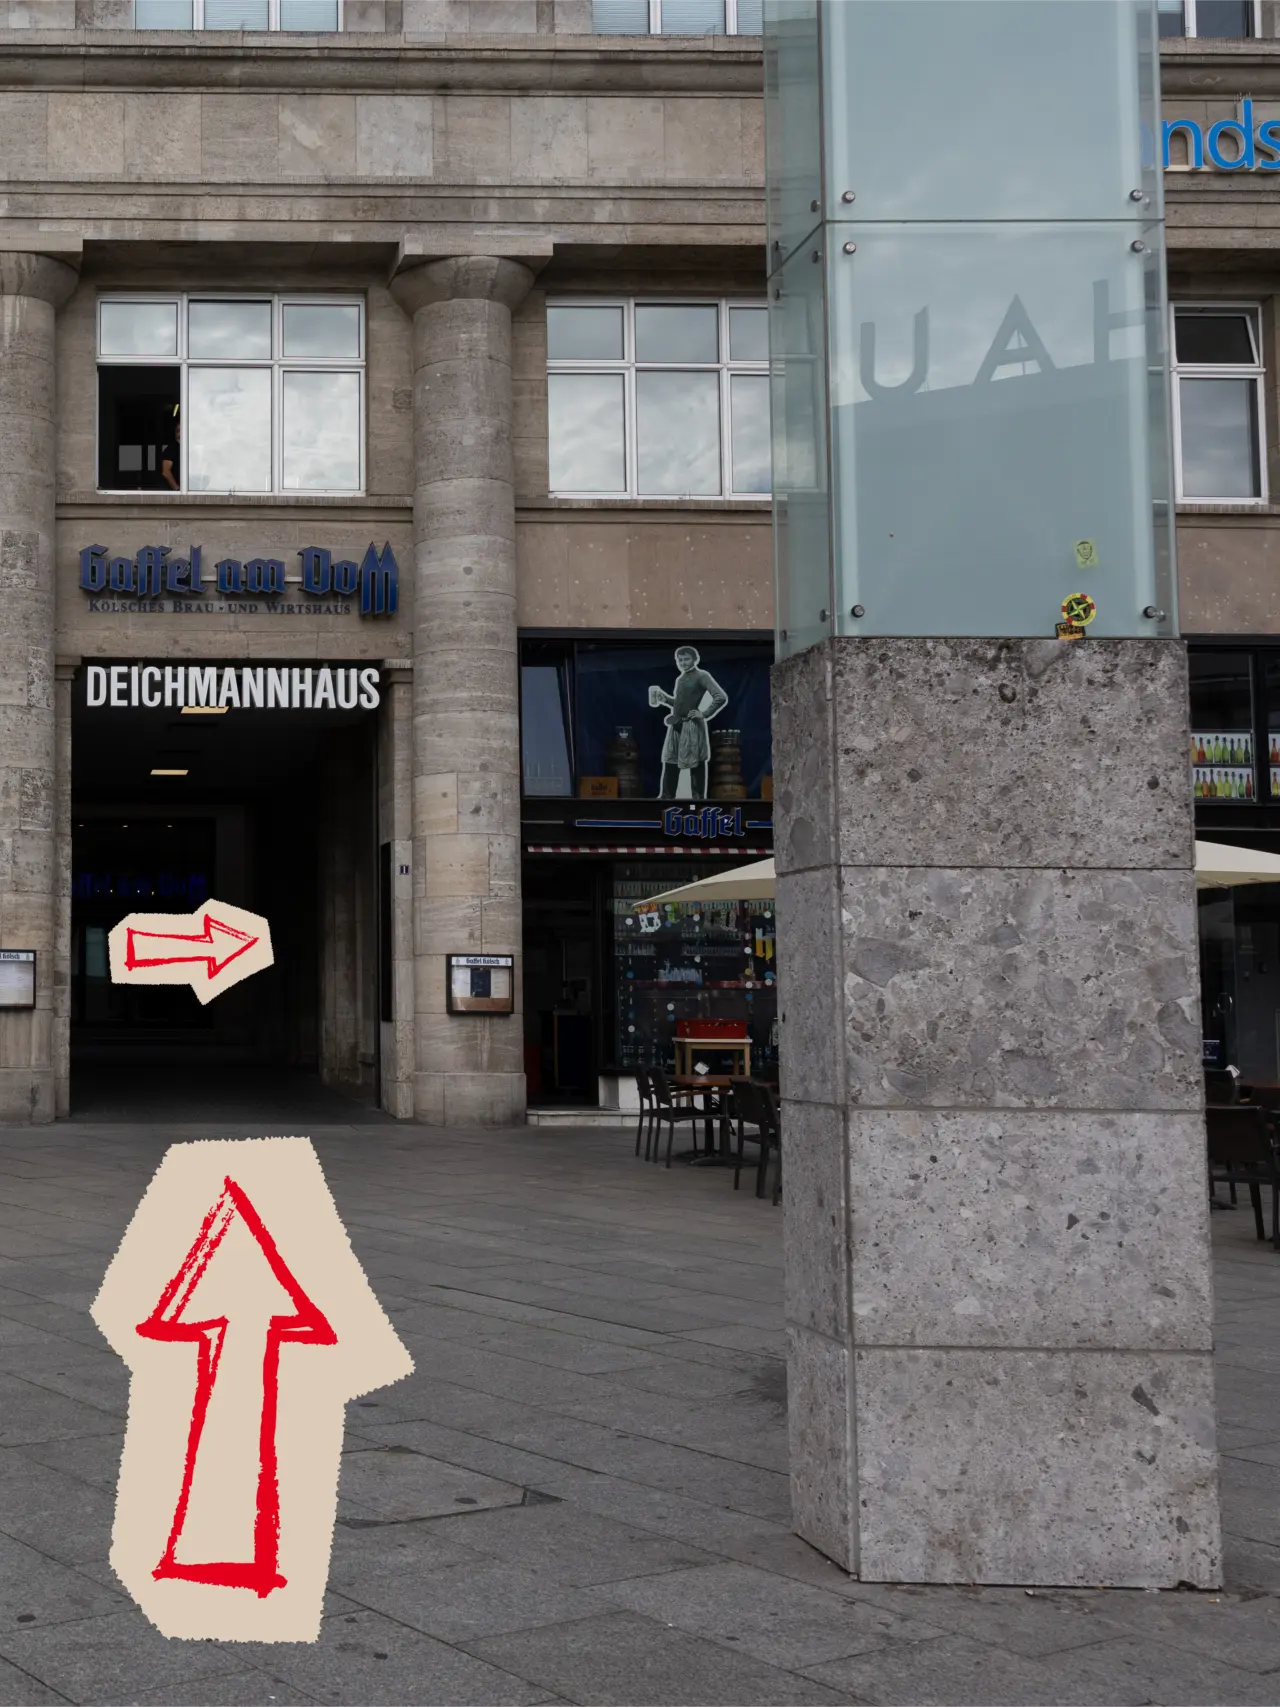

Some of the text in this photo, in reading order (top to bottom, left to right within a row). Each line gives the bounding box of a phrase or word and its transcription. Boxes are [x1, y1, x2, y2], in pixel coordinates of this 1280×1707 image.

[80, 543, 208, 597] Gaffel
[215, 558, 289, 594] am
[266, 601, 352, 615] WIRTSHAUS
[86, 665, 381, 710] DEICHMANNHAUS
[664, 806, 745, 838] Gaffel
